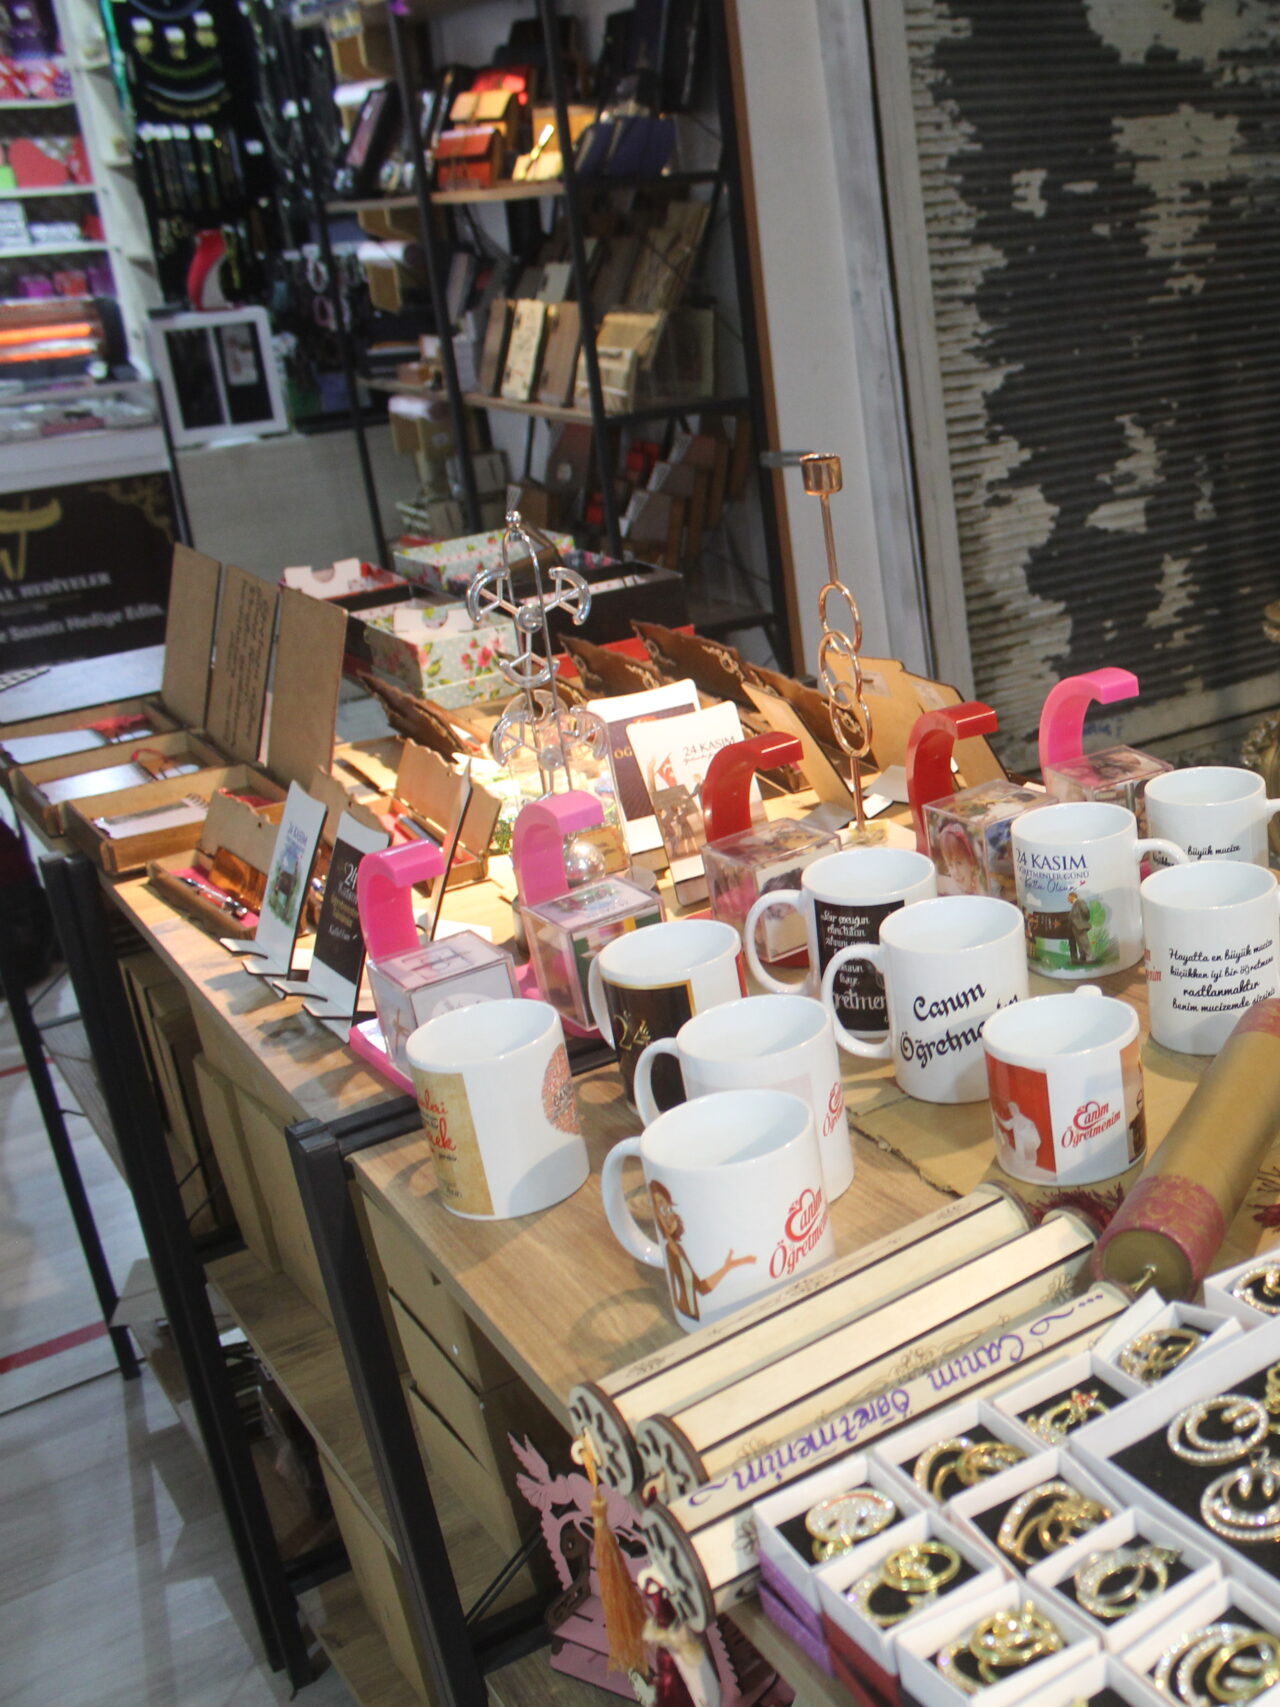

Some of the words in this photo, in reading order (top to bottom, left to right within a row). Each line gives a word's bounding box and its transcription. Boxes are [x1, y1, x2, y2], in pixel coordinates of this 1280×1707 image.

[1031, 853, 1088, 871] KASIM
[1186, 844, 1214, 861] büyük
[1215, 843, 1241, 855] mucize
[1169, 947, 1210, 966] Hayatta
[1211, 953, 1223, 962] en
[1224, 944, 1252, 964] büyük
[1170, 964, 1209, 981] küçükken
[1210, 968, 1223, 983] iyi
[1224, 964, 1238, 977] bir
[1182, 978, 1260, 998] rastlanmaktır
[913, 983, 987, 1022] Canım
[1172, 998, 1199, 1013] benim
[1200, 996, 1251, 1013] mucizemde
[1073, 1101, 1109, 1130] Canım
[1061, 1110, 1121, 1148] Öğretmenim
[928, 1332, 1025, 1392] Canım
[732, 1388, 912, 1493] Öğretmenim
